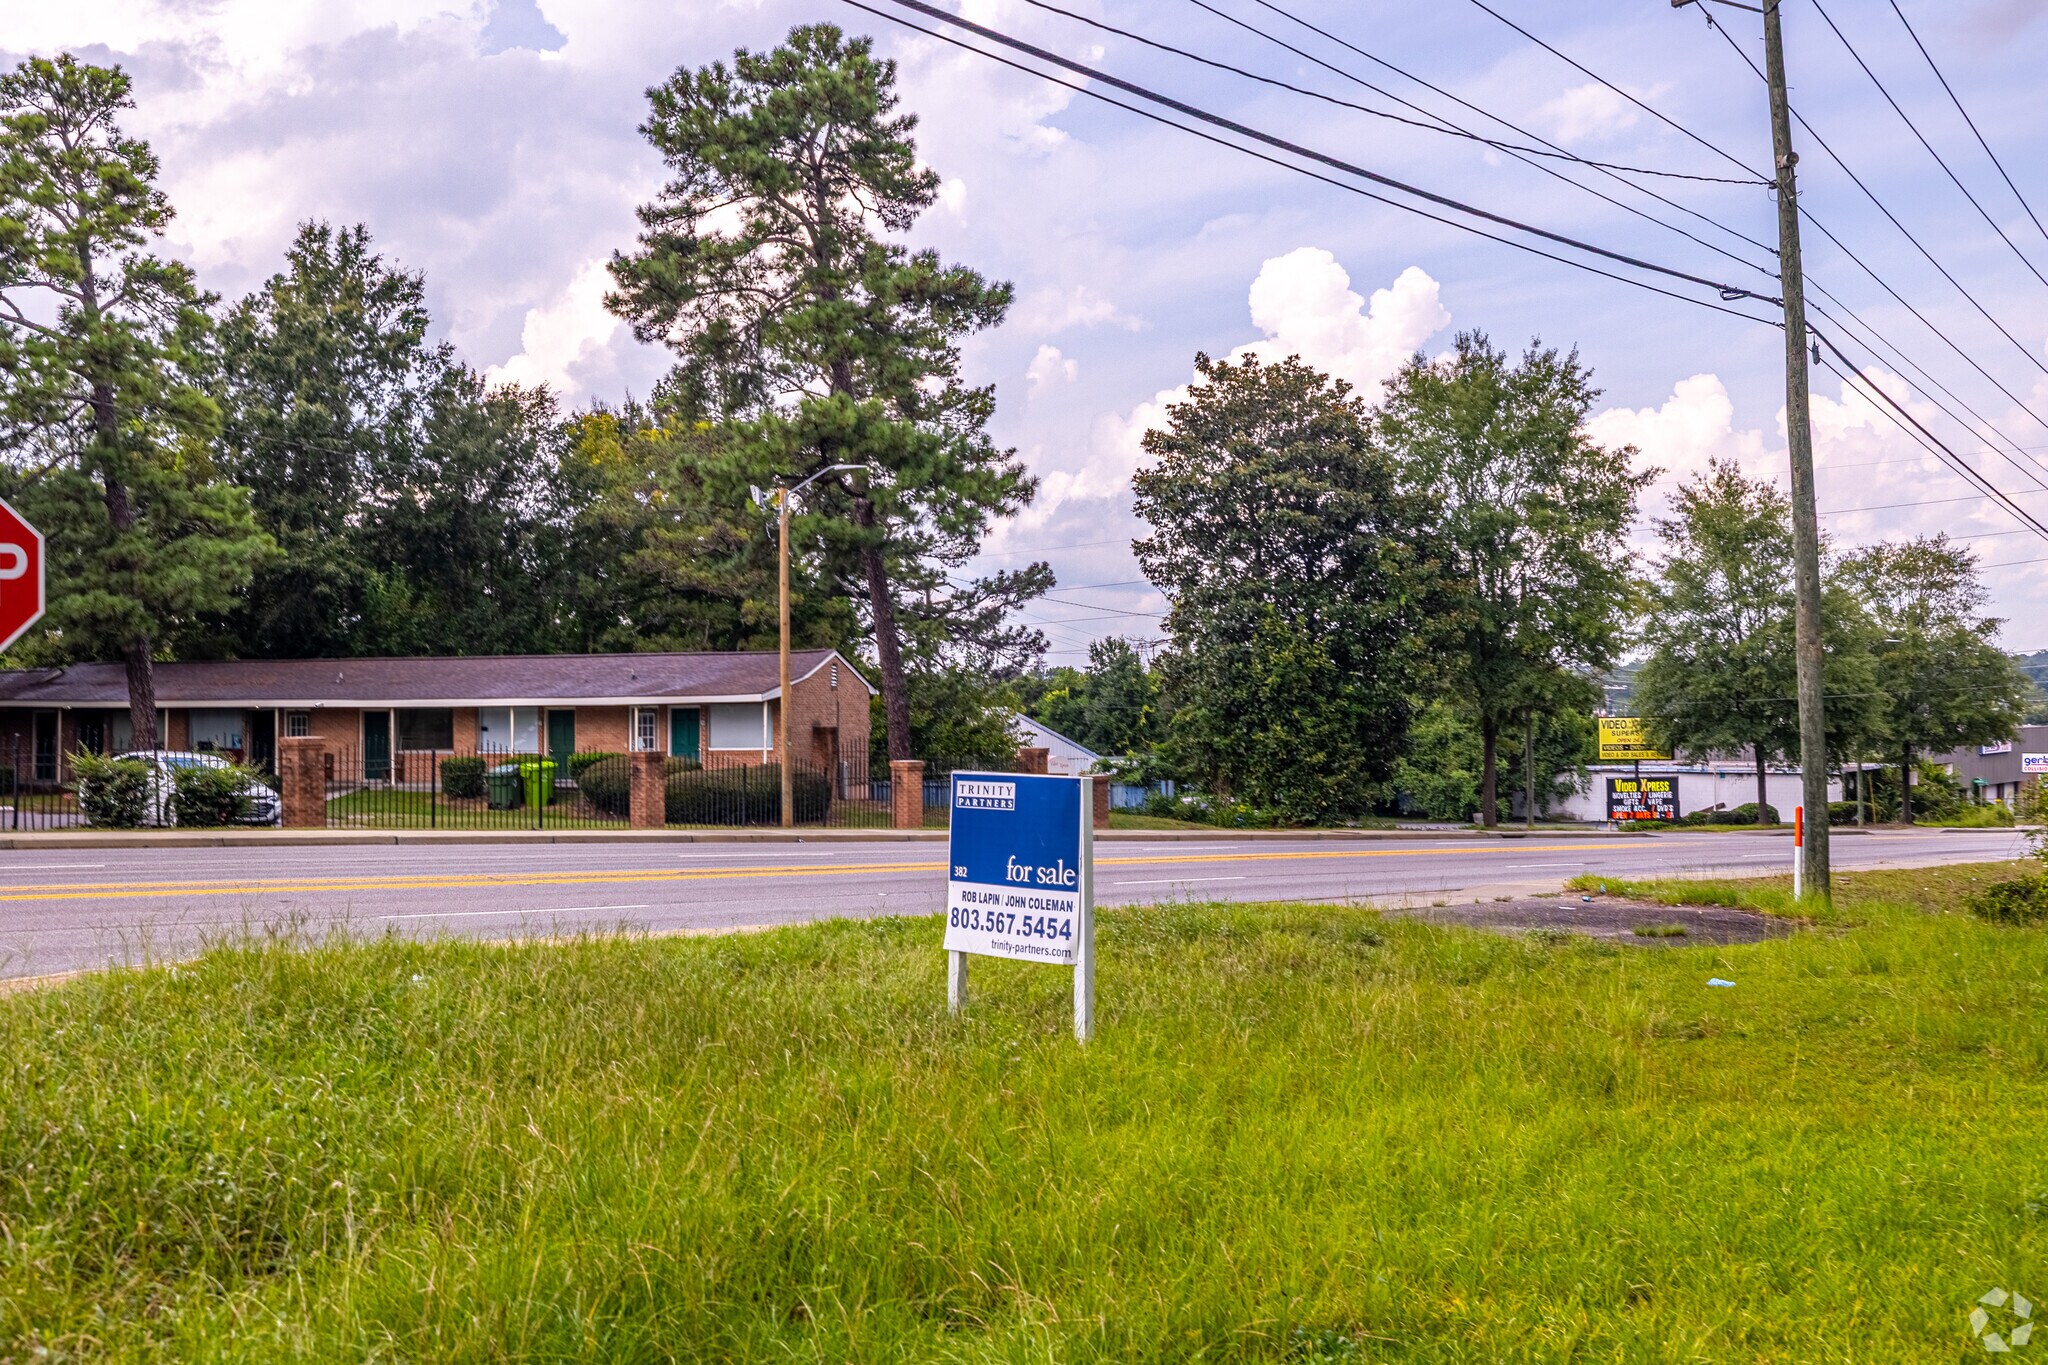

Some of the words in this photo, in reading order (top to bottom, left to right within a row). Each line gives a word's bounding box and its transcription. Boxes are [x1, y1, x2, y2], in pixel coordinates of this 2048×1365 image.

[1601, 719, 1627, 730] VIDEO
[960, 784, 1013, 796] TRINITY
[958, 797, 1013, 809] PARTNERS
[1612, 811, 1628, 819] OPEN
[1635, 811, 1651, 819] DAYS
[954, 865, 968, 877] 382
[1006, 855, 1033, 882] for
[1036, 858, 1076, 886] sale
[962, 890, 976, 903] ROB
[978, 892, 1000, 905] LAPIN
[1005, 895, 1026, 908] JOHN
[1028, 897, 1073, 912] COLEMAN
[950, 907, 1072, 940] 803.567.5454
[991, 939, 1072, 958] trinity-partners.com
